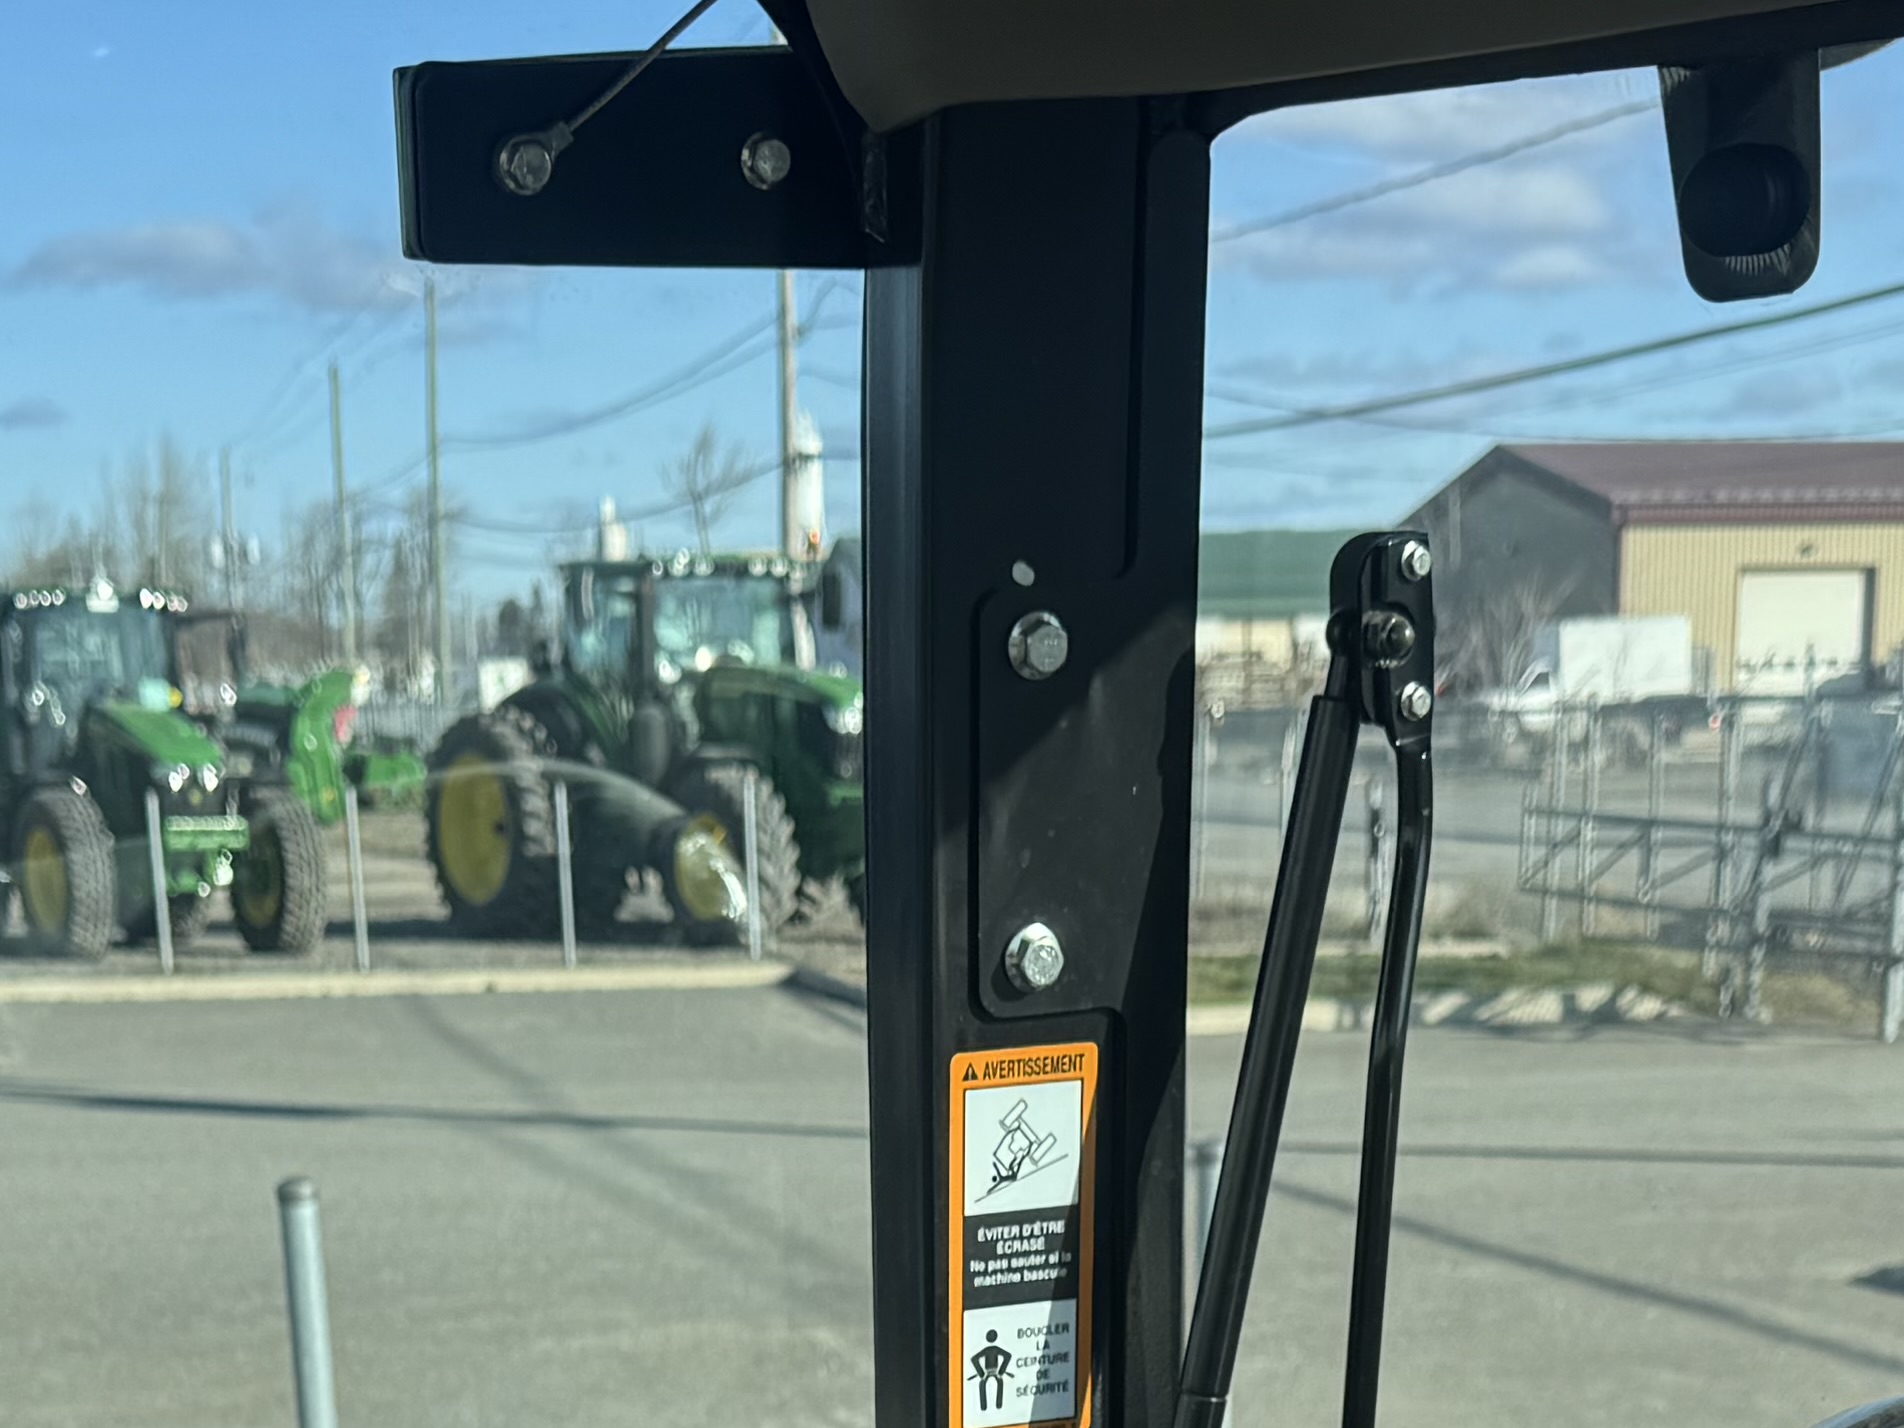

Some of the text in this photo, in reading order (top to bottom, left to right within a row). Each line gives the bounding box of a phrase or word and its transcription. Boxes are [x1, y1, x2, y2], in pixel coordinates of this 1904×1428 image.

[983, 1054, 1085, 1080] AVERTISSEMENT
[977, 1225, 1020, 1242] ÉVITER
[996, 1236, 1045, 1255] ÉCRASÉ
[1017, 1323, 1069, 1339] BOUCLER
[1036, 1339, 1050, 1351] LA
[1016, 1352, 1069, 1368] CEINTURE
[1036, 1369, 1050, 1380] DE
[1016, 1379, 1069, 1397] SÉCURITÉ
